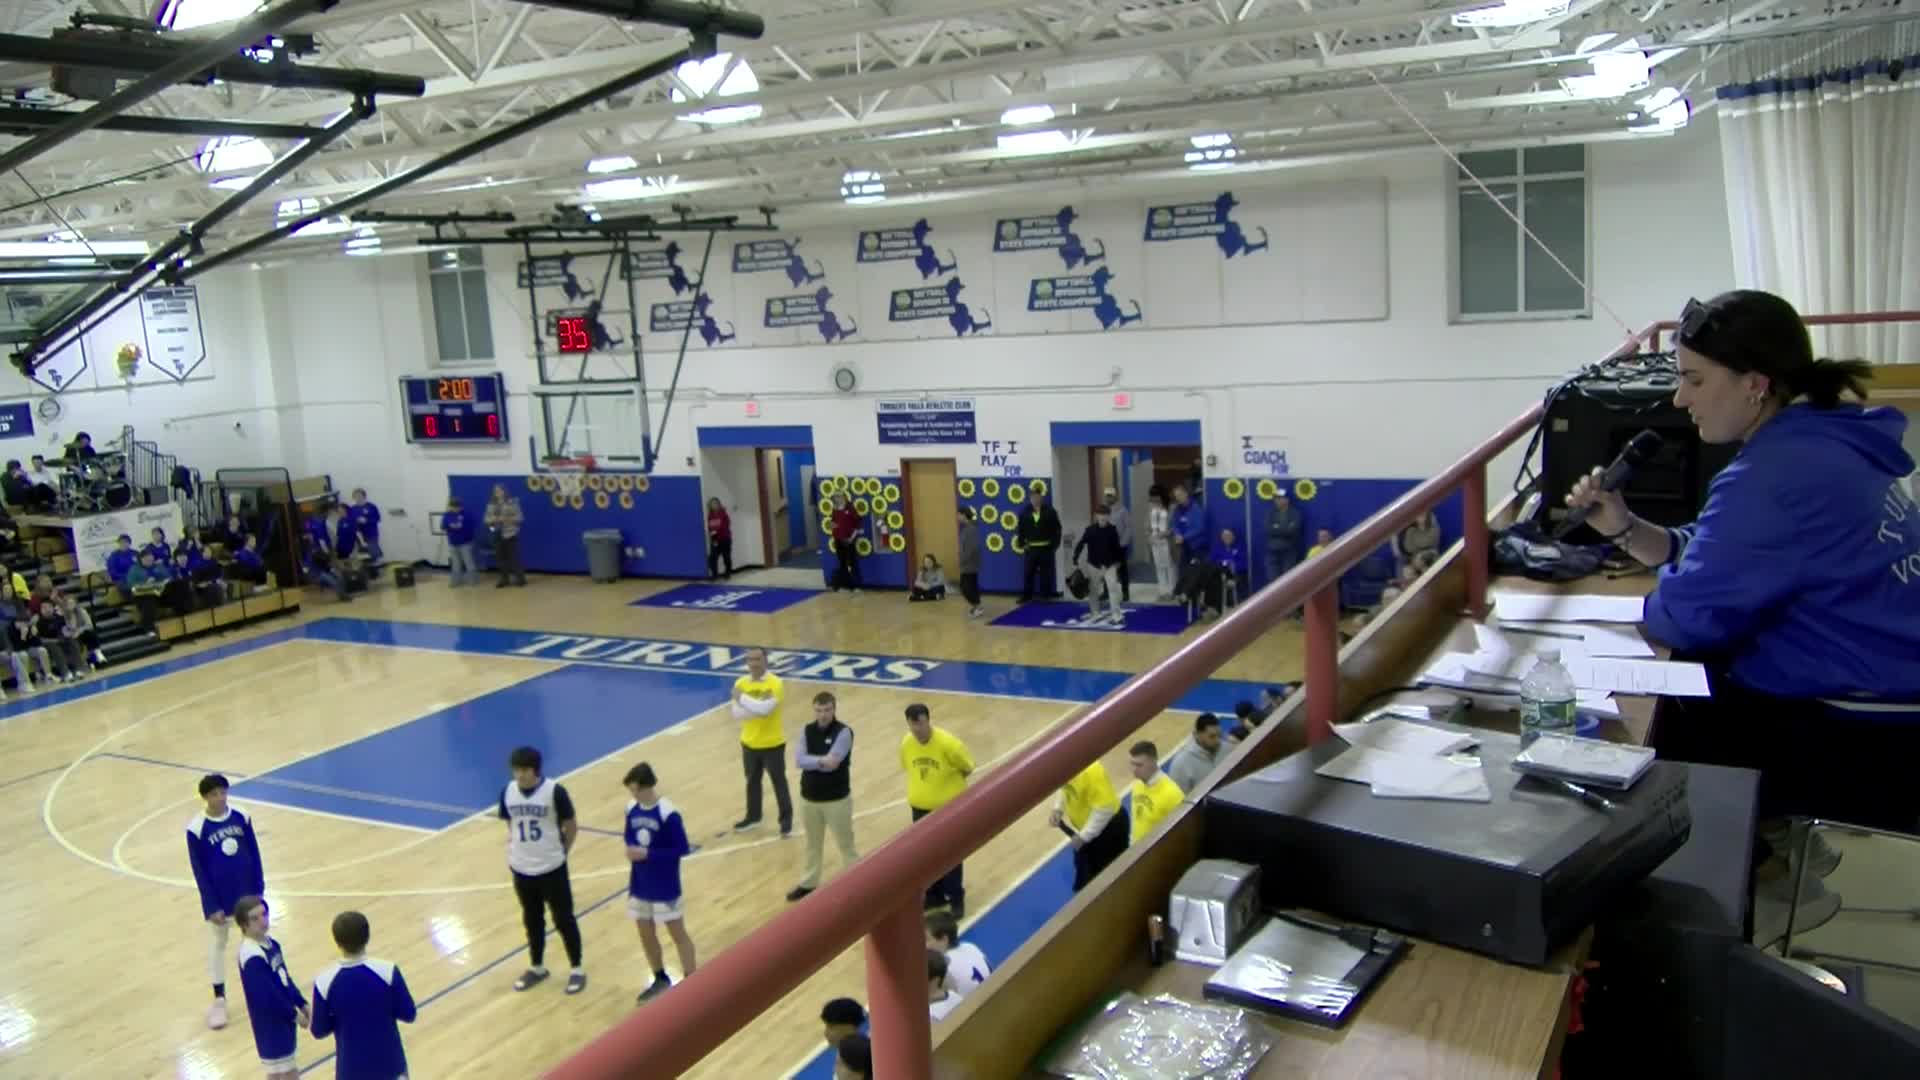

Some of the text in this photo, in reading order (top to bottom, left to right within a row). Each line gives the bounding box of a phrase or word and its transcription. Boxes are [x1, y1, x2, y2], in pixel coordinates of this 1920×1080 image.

[559, 319, 588, 349] 35
[439, 379, 473, 400] 2:00
[425, 415, 498, 437] 0 1 0
[981, 456, 1008, 466] PLAY
[1243, 450, 1286, 464] COACH
[1004, 466, 1022, 476] FOR
[505, 633, 943, 684] TURNERS
[518, 820, 543, 842] 15
